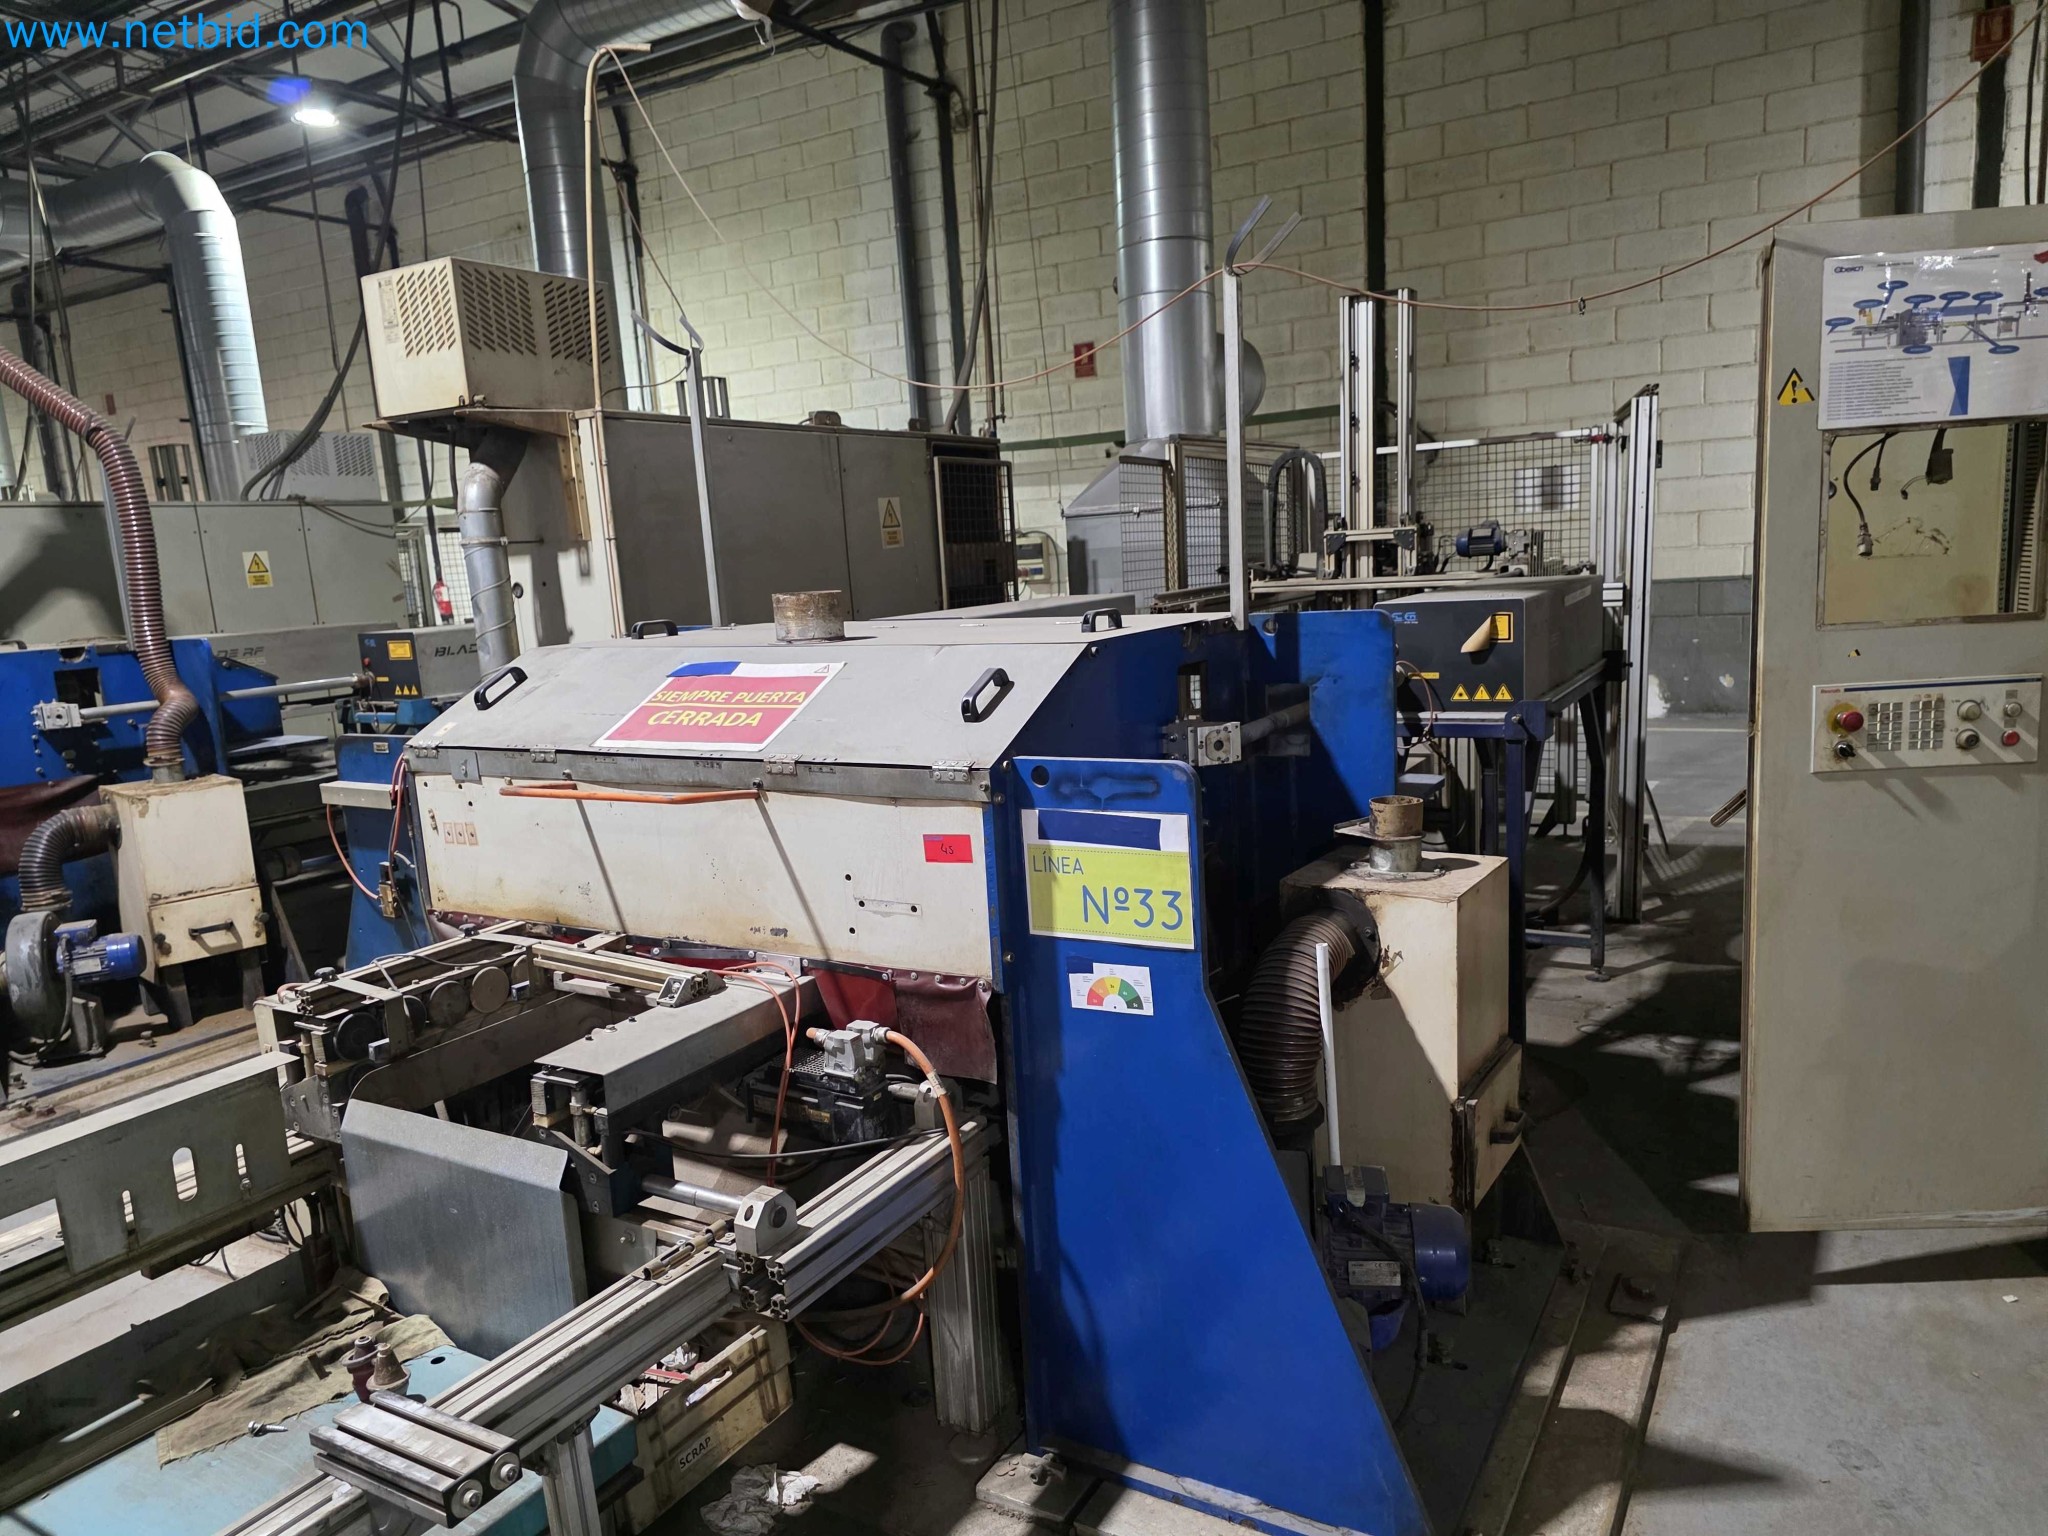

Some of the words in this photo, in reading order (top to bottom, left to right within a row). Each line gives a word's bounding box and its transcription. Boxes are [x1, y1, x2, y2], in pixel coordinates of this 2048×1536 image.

[651, 690, 732, 703] SIEMPRE
[736, 691, 806, 703] PUERTA
[647, 710, 763, 727] CERRADA
[1033, 851, 1084, 875] LÍNEA
[680, 1436, 711, 1469] SCRAP
